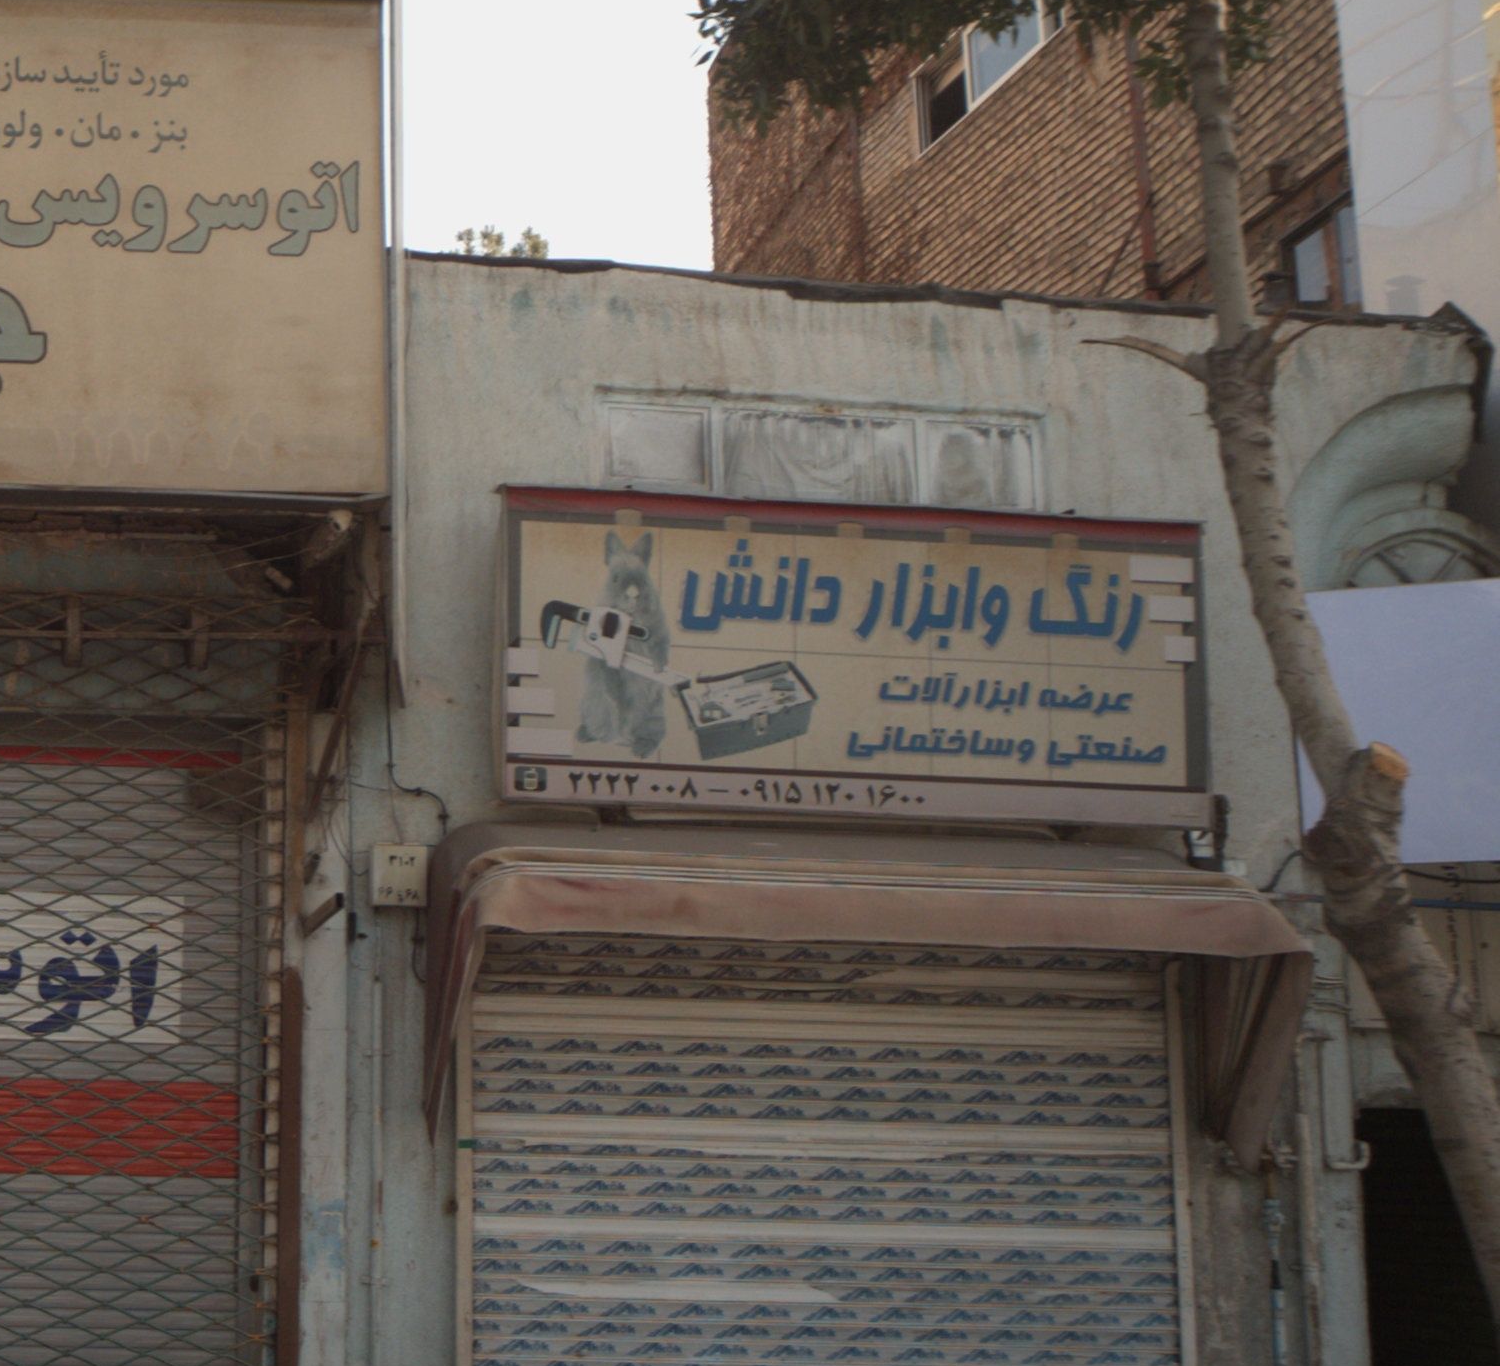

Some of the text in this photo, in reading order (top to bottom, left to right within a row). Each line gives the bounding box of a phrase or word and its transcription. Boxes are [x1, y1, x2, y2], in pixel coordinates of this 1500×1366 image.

[127, 66, 190, 98] مورد
[151, 118, 189, 153] بنز
[678, 537, 843, 633] دانش
[1028, 563, 1145, 651] رنگ
[1037, 685, 1134, 715] عرضه
[1045, 734, 1168, 767] صنعتی
